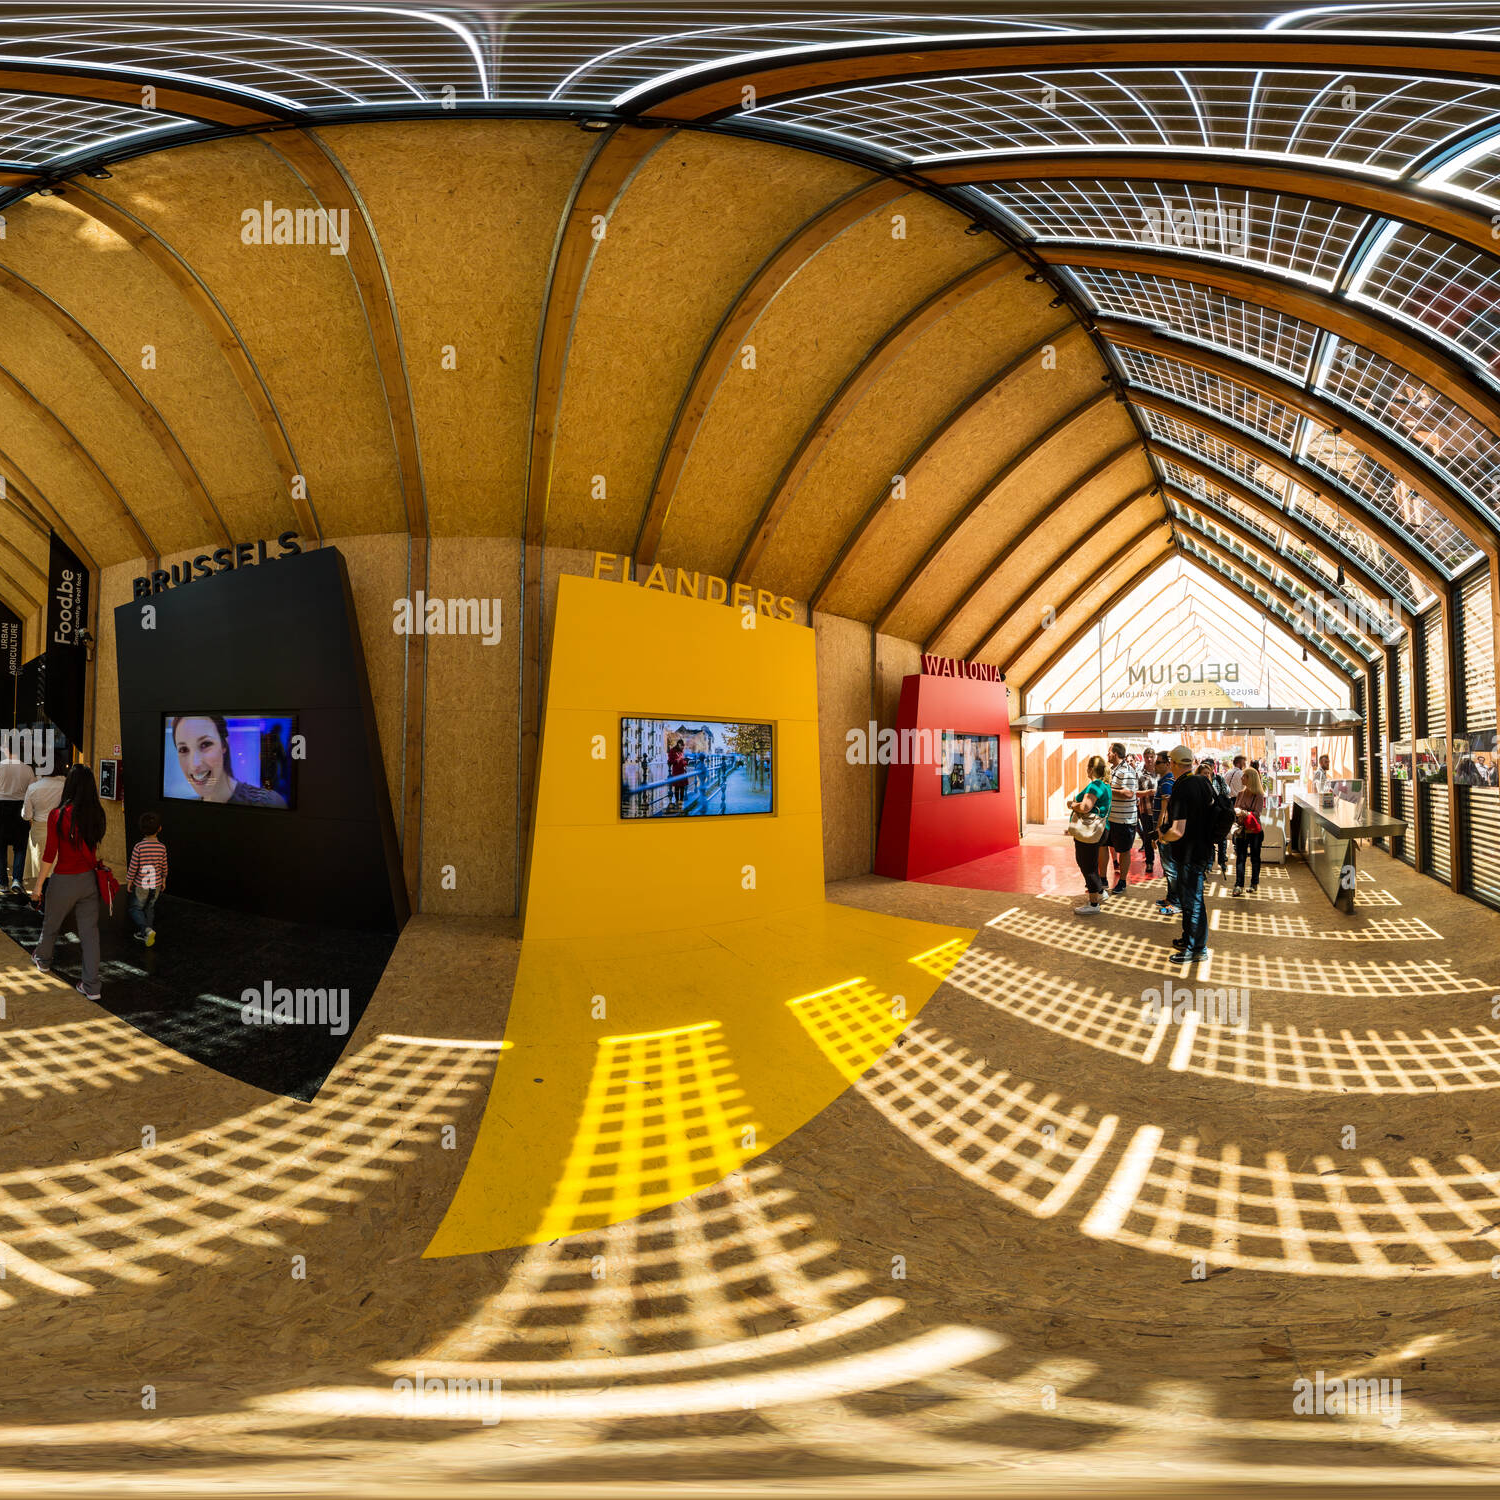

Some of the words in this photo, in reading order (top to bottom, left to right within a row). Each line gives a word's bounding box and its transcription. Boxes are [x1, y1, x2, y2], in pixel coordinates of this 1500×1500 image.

[133, 531, 301, 600] BRUSSELS
[593, 551, 797, 622] FLANDERS
[1, 622, 9, 650] URBAN
[54, 569, 74, 645] Food.be
[9, 623, 18, 675] AGRICULTURE
[923, 653, 1002, 682] WALLONIA
